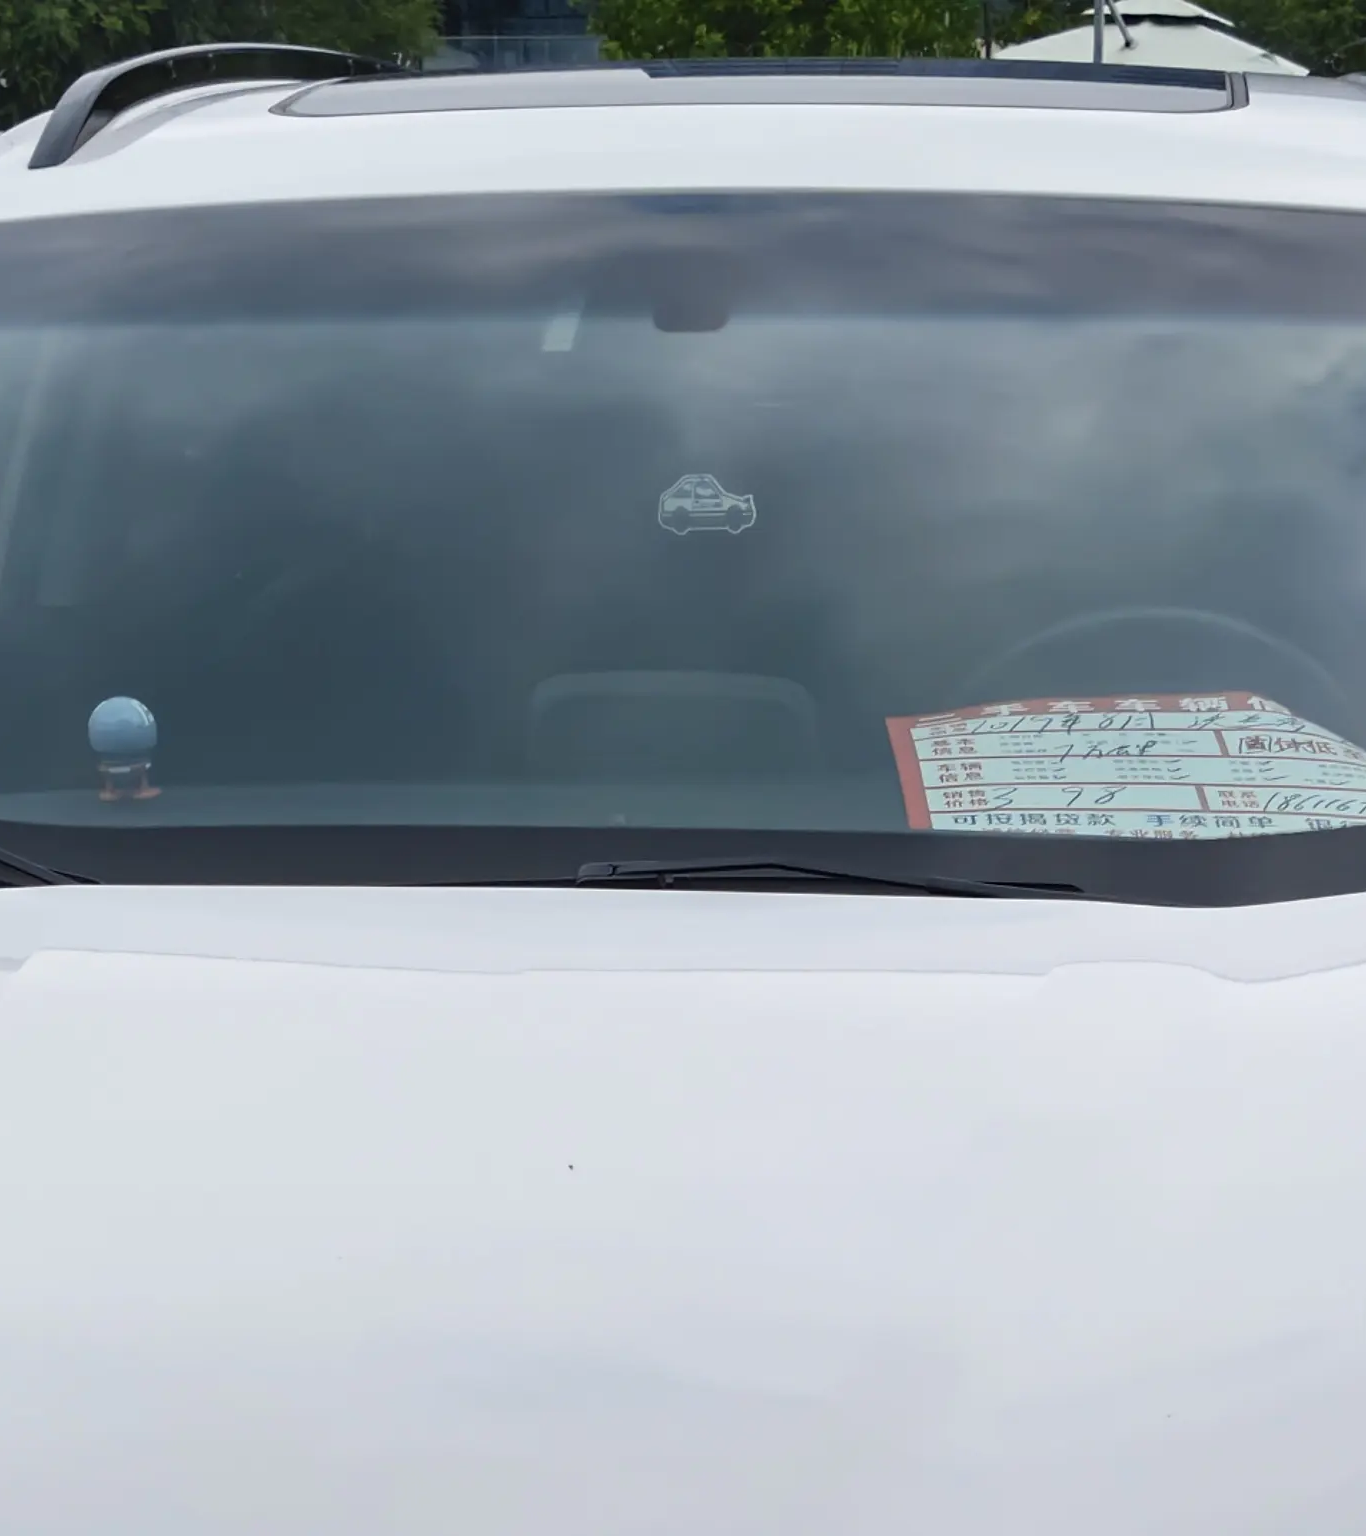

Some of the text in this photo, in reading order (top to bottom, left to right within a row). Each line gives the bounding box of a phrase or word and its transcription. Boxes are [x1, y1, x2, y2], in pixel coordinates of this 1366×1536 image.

[952, 813, 1116, 826] 可按揭贷款
[1146, 814, 1278, 829] 手续简单
